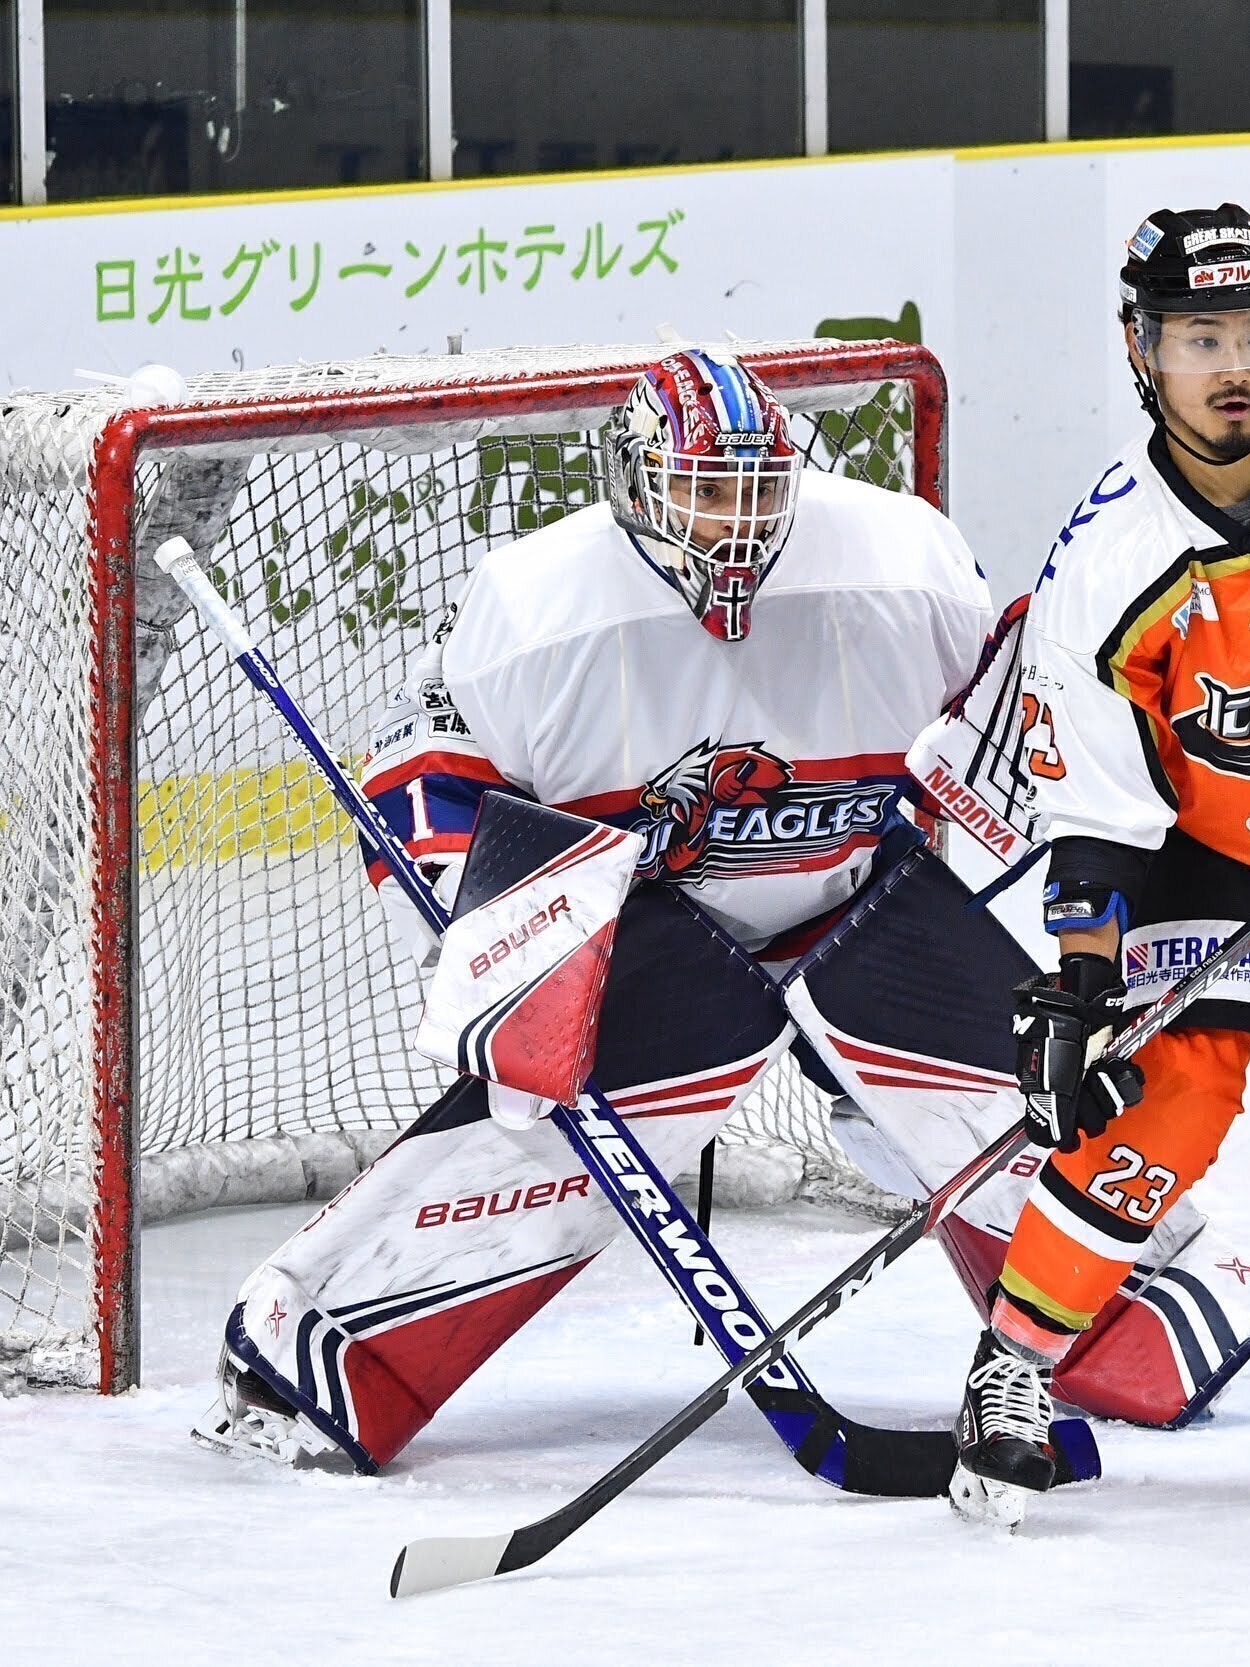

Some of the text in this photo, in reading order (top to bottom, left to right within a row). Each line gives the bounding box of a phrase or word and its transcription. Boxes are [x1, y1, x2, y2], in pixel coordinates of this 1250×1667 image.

[95, 208, 686, 325] 日光グリーンホテルズ
[715, 432, 775, 446] BAUER
[1034, 460, 1138, 594] TKC
[260, 688, 336, 791] SHER-WOOD
[405, 776, 434, 843] 1
[707, 794, 884, 842] EAGLES
[923, 763, 1018, 855] VAUGHN
[468, 894, 572, 980] BAUER
[1118, 959, 1230, 1061] SPEED
[414, 1173, 590, 1230] BAUER
[1087, 1143, 1178, 1227] 23
